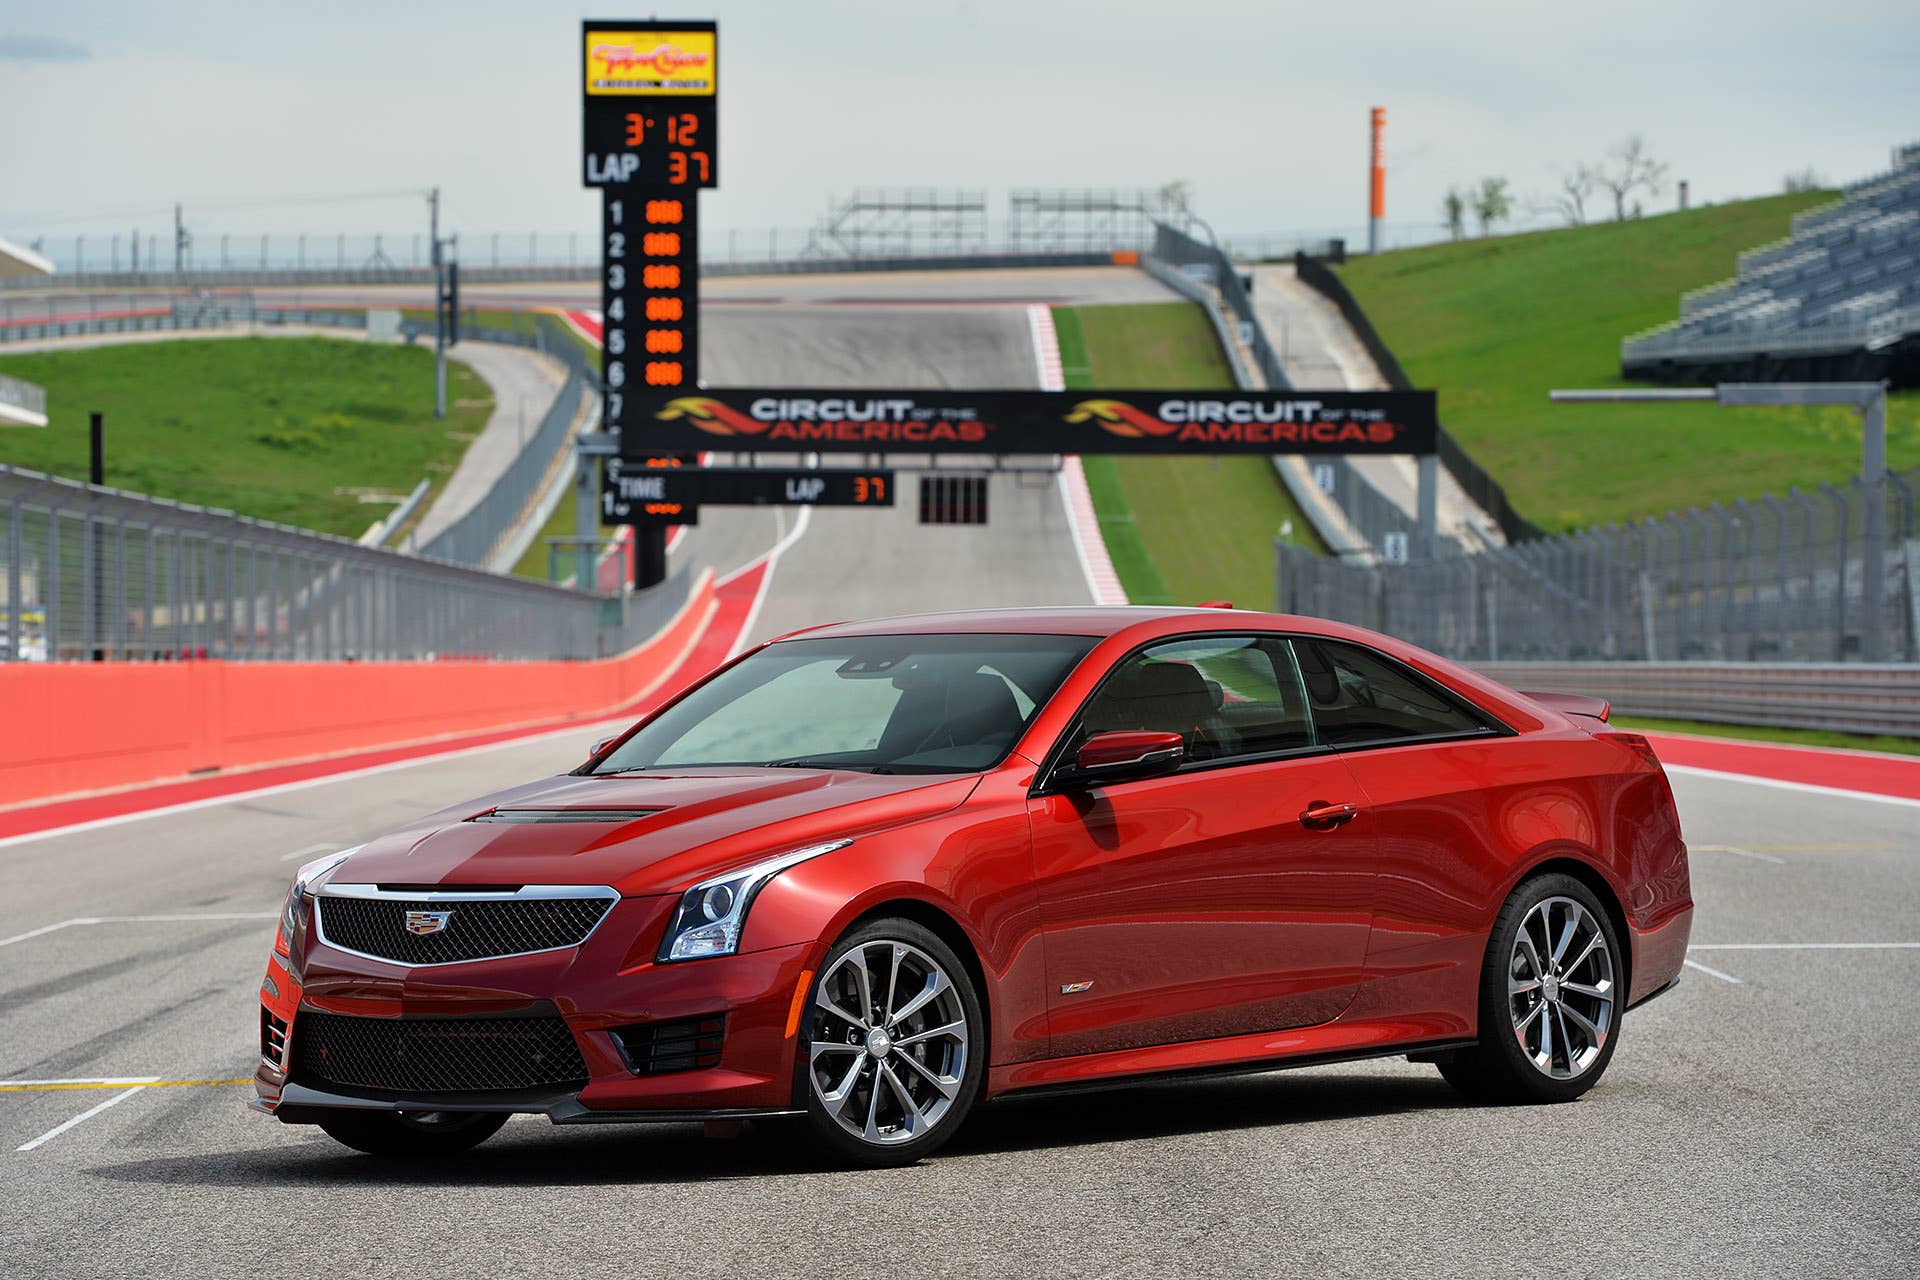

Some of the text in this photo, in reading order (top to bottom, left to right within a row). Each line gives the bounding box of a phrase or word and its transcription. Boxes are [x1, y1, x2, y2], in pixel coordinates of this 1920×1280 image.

[587, 151, 709, 184] LAP 37
[609, 201, 623, 225] 1
[608, 232, 625, 257] 2
[608, 264, 625, 290] 3
[608, 297, 625, 322] 4
[608, 328, 625, 354] 5
[608, 360, 625, 387] 6
[608, 393, 622, 419] 7
[750, 398, 915, 421] CIRCUIT
[1158, 400, 1323, 423] CIRCUIT
[769, 421, 985, 441] AMERICAS
[1179, 422, 1395, 442] AMERICAS
[619, 476, 885, 502] TIME LAP 37
